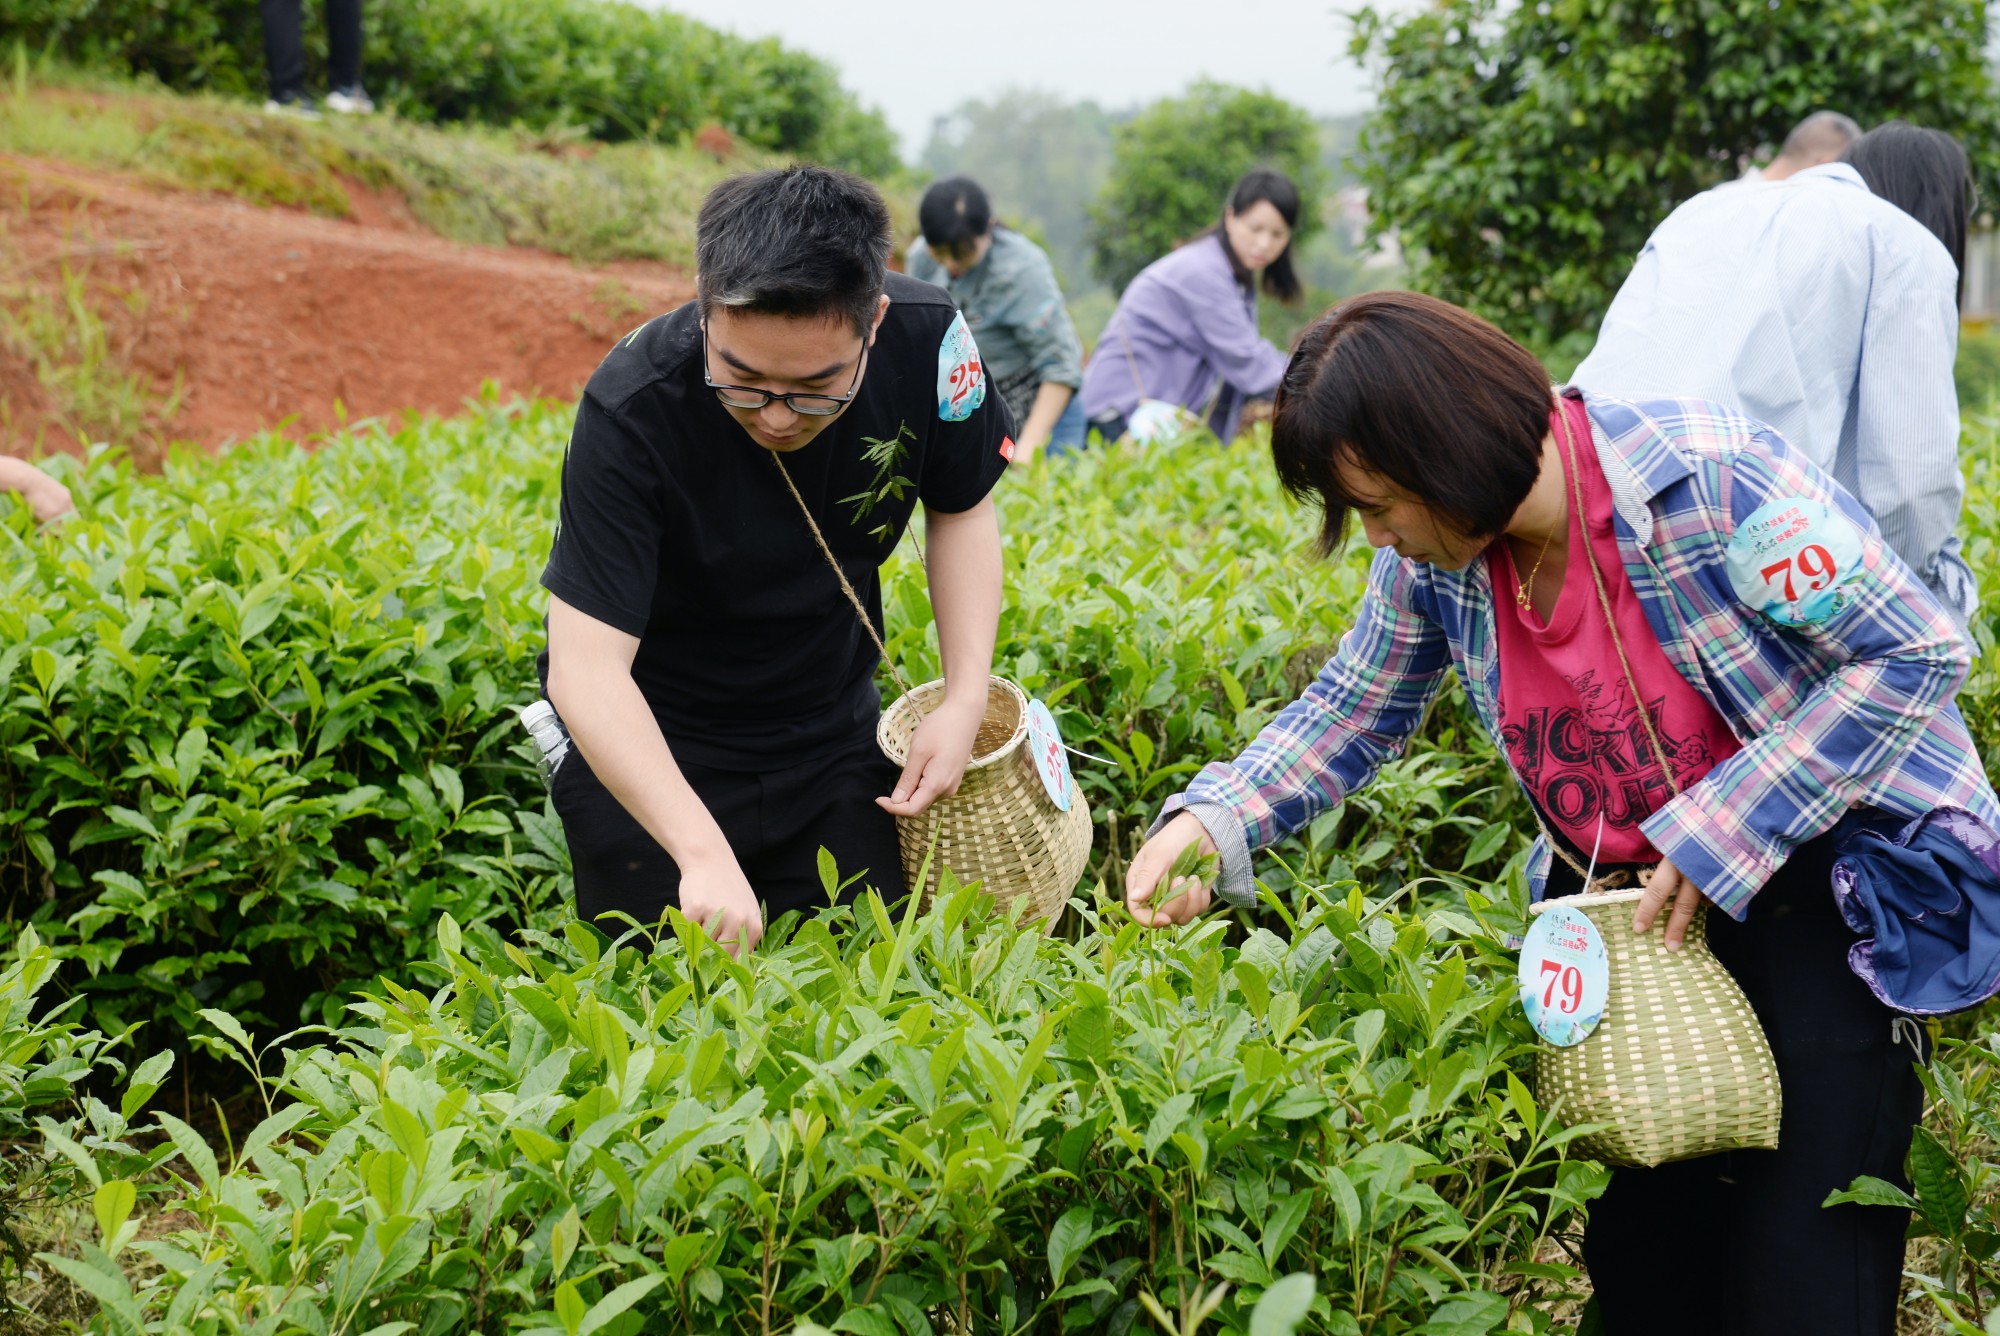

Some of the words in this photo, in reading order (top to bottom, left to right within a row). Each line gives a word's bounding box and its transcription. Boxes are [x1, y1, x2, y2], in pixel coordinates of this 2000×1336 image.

[950, 348, 982, 404] 28
[1760, 544, 1837, 602] 79
[1046, 732, 1062, 793] 28
[1540, 959, 1583, 1014] 79
